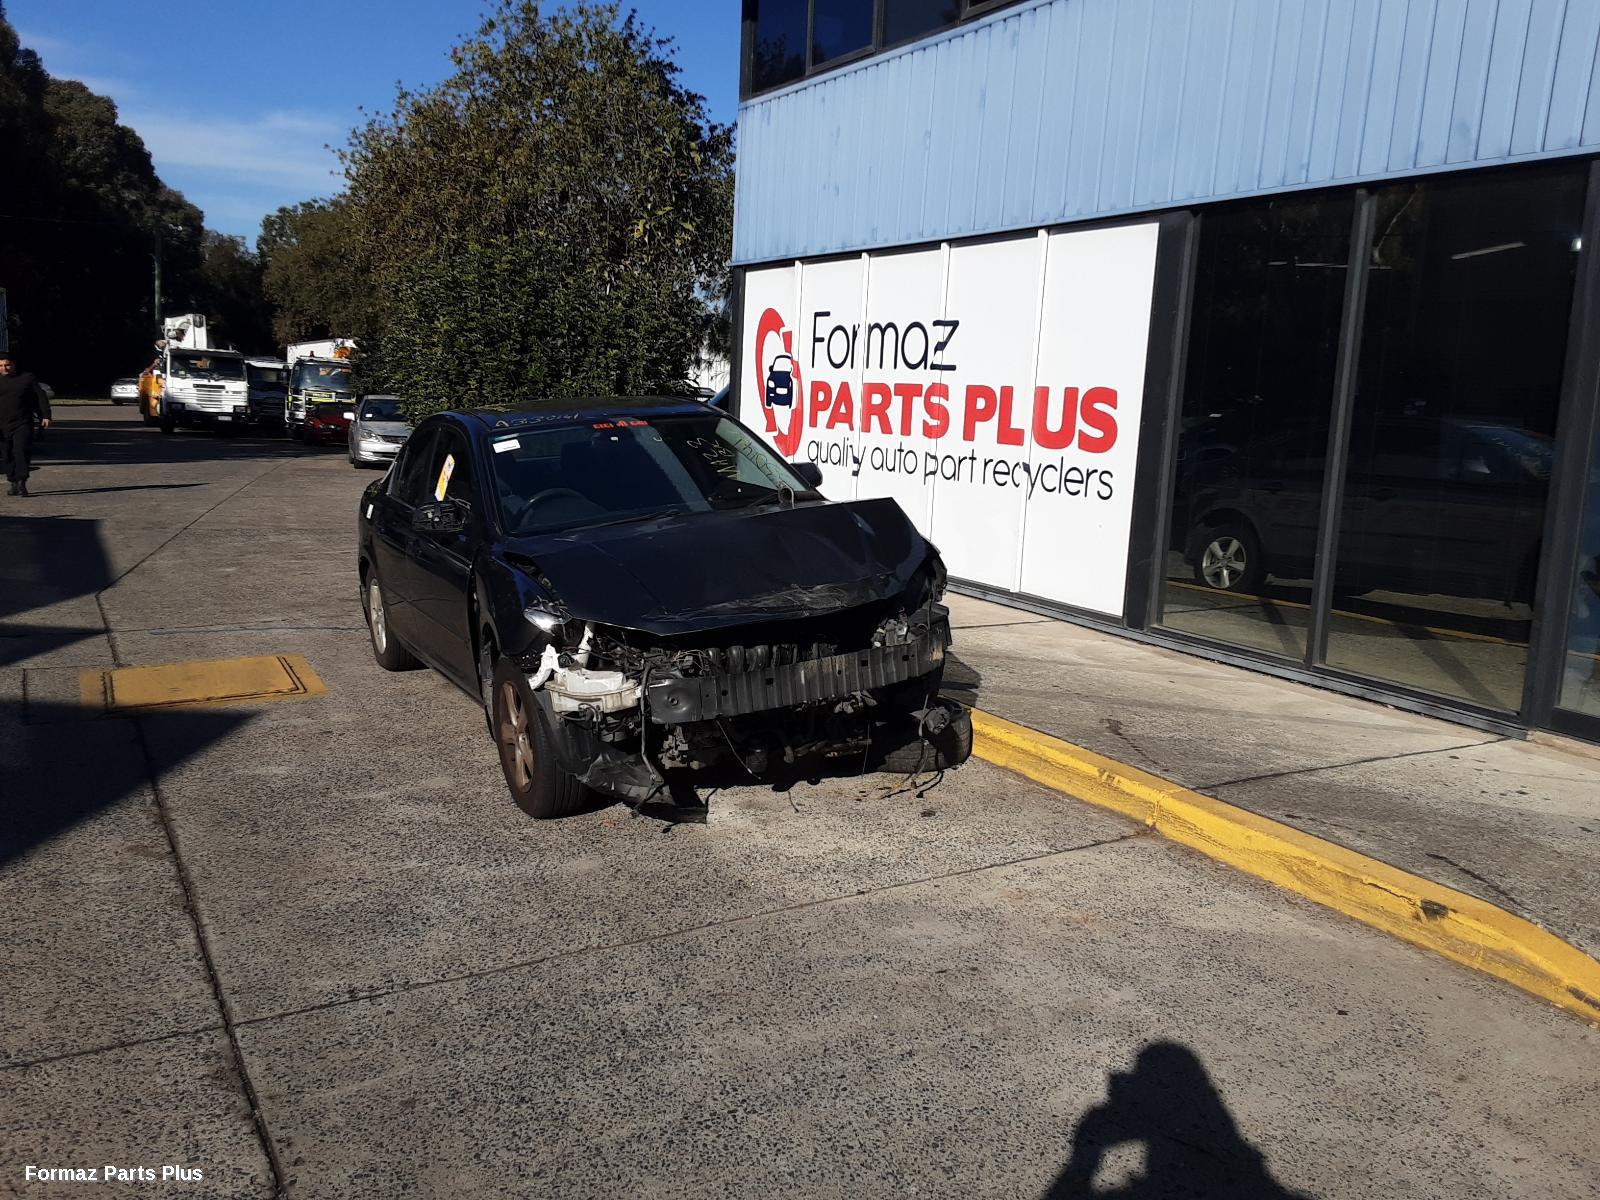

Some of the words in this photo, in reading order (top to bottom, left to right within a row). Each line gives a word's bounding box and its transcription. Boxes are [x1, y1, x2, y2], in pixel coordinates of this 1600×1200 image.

[812, 311, 959, 371] Formaz
[809, 381, 951, 440] PARTS
[962, 384, 1119, 454] PLUS
[807, 436, 866, 476] qualiy
[870, 440, 918, 475] auto
[924, 449, 977, 485] part
[983, 456, 1114, 501] recyclers
